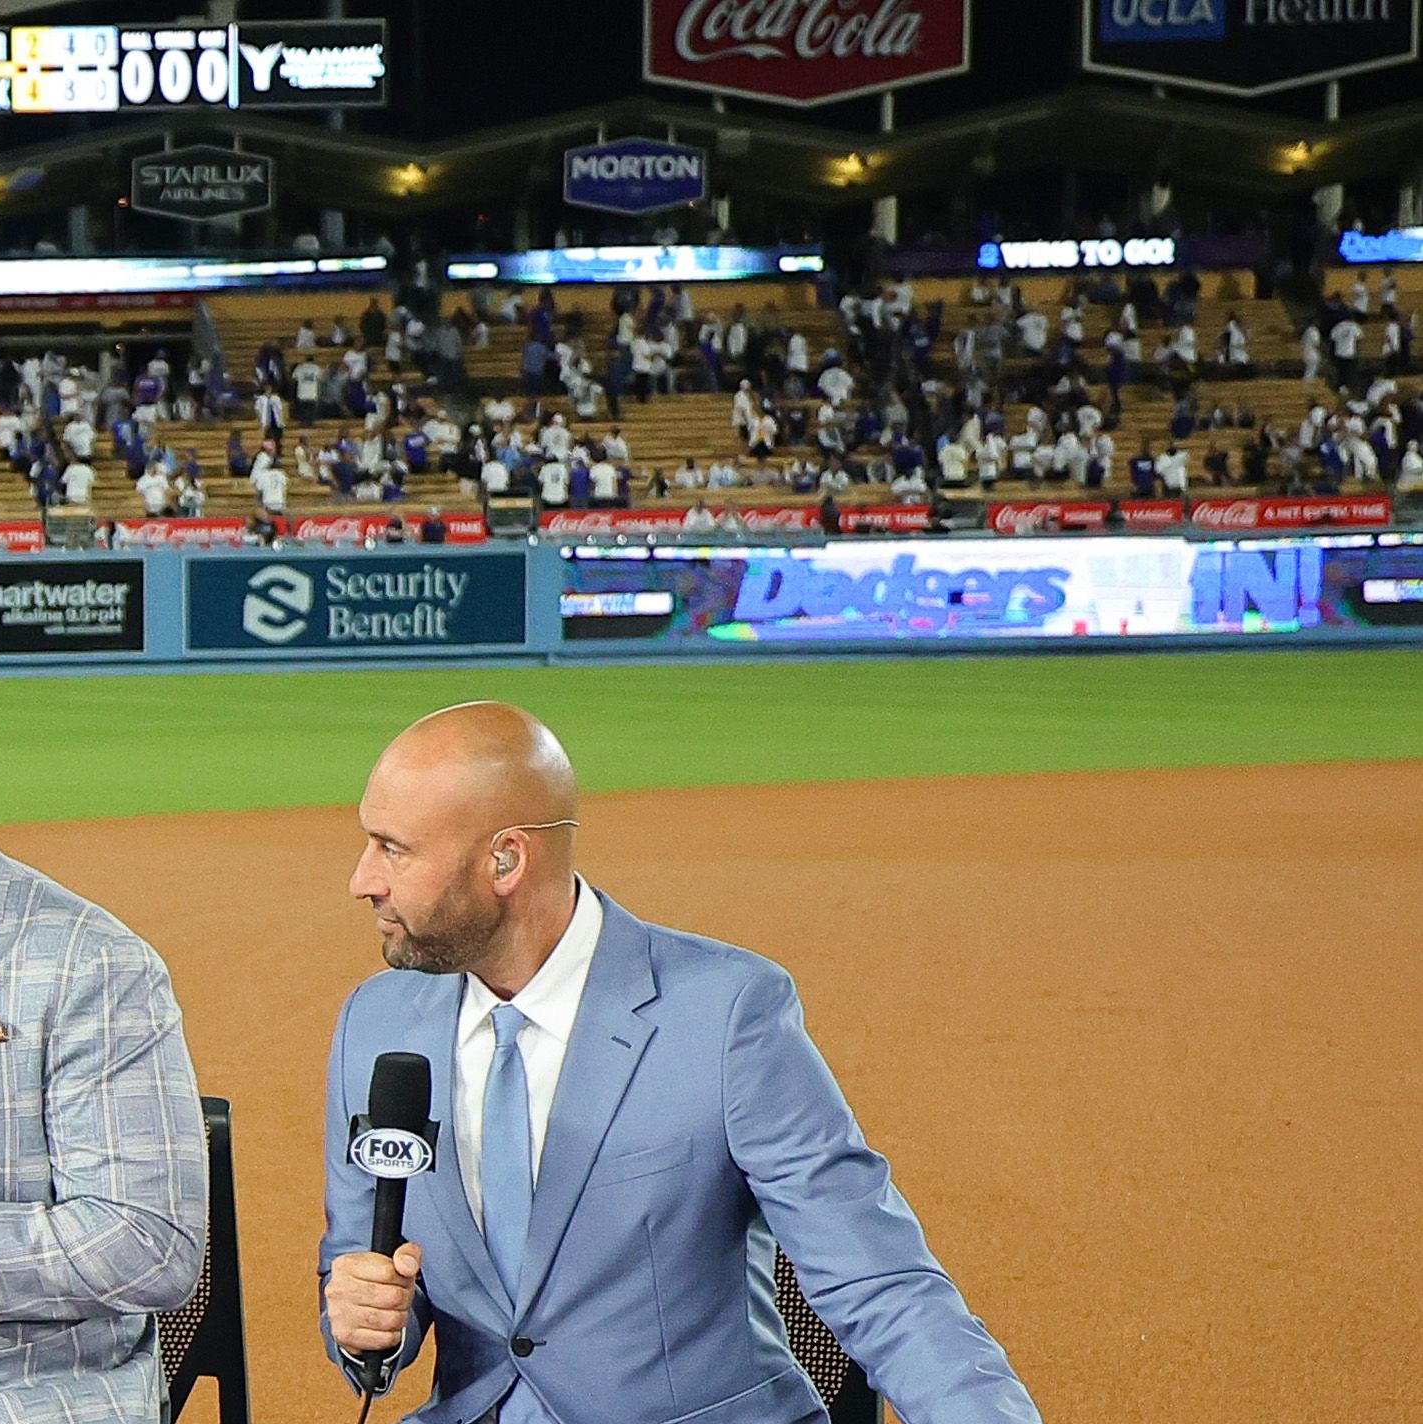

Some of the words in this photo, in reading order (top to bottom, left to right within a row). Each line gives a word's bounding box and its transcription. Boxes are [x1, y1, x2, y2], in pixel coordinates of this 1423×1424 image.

[140, 165, 264, 184] STARLUX
[571, 155, 699, 180] MORTON
[1001, 240, 1079, 268] WINS
[1080, 239, 1123, 266] TO
[1124, 238, 1175, 264] GO!
[325, 564, 469, 606] Security
[734, 553, 1070, 628] Dodgers
[327, 603, 451, 640] Benefit
[370, 1139, 414, 1160] FOX
[368, 1158, 415, 1169] SPORTS
